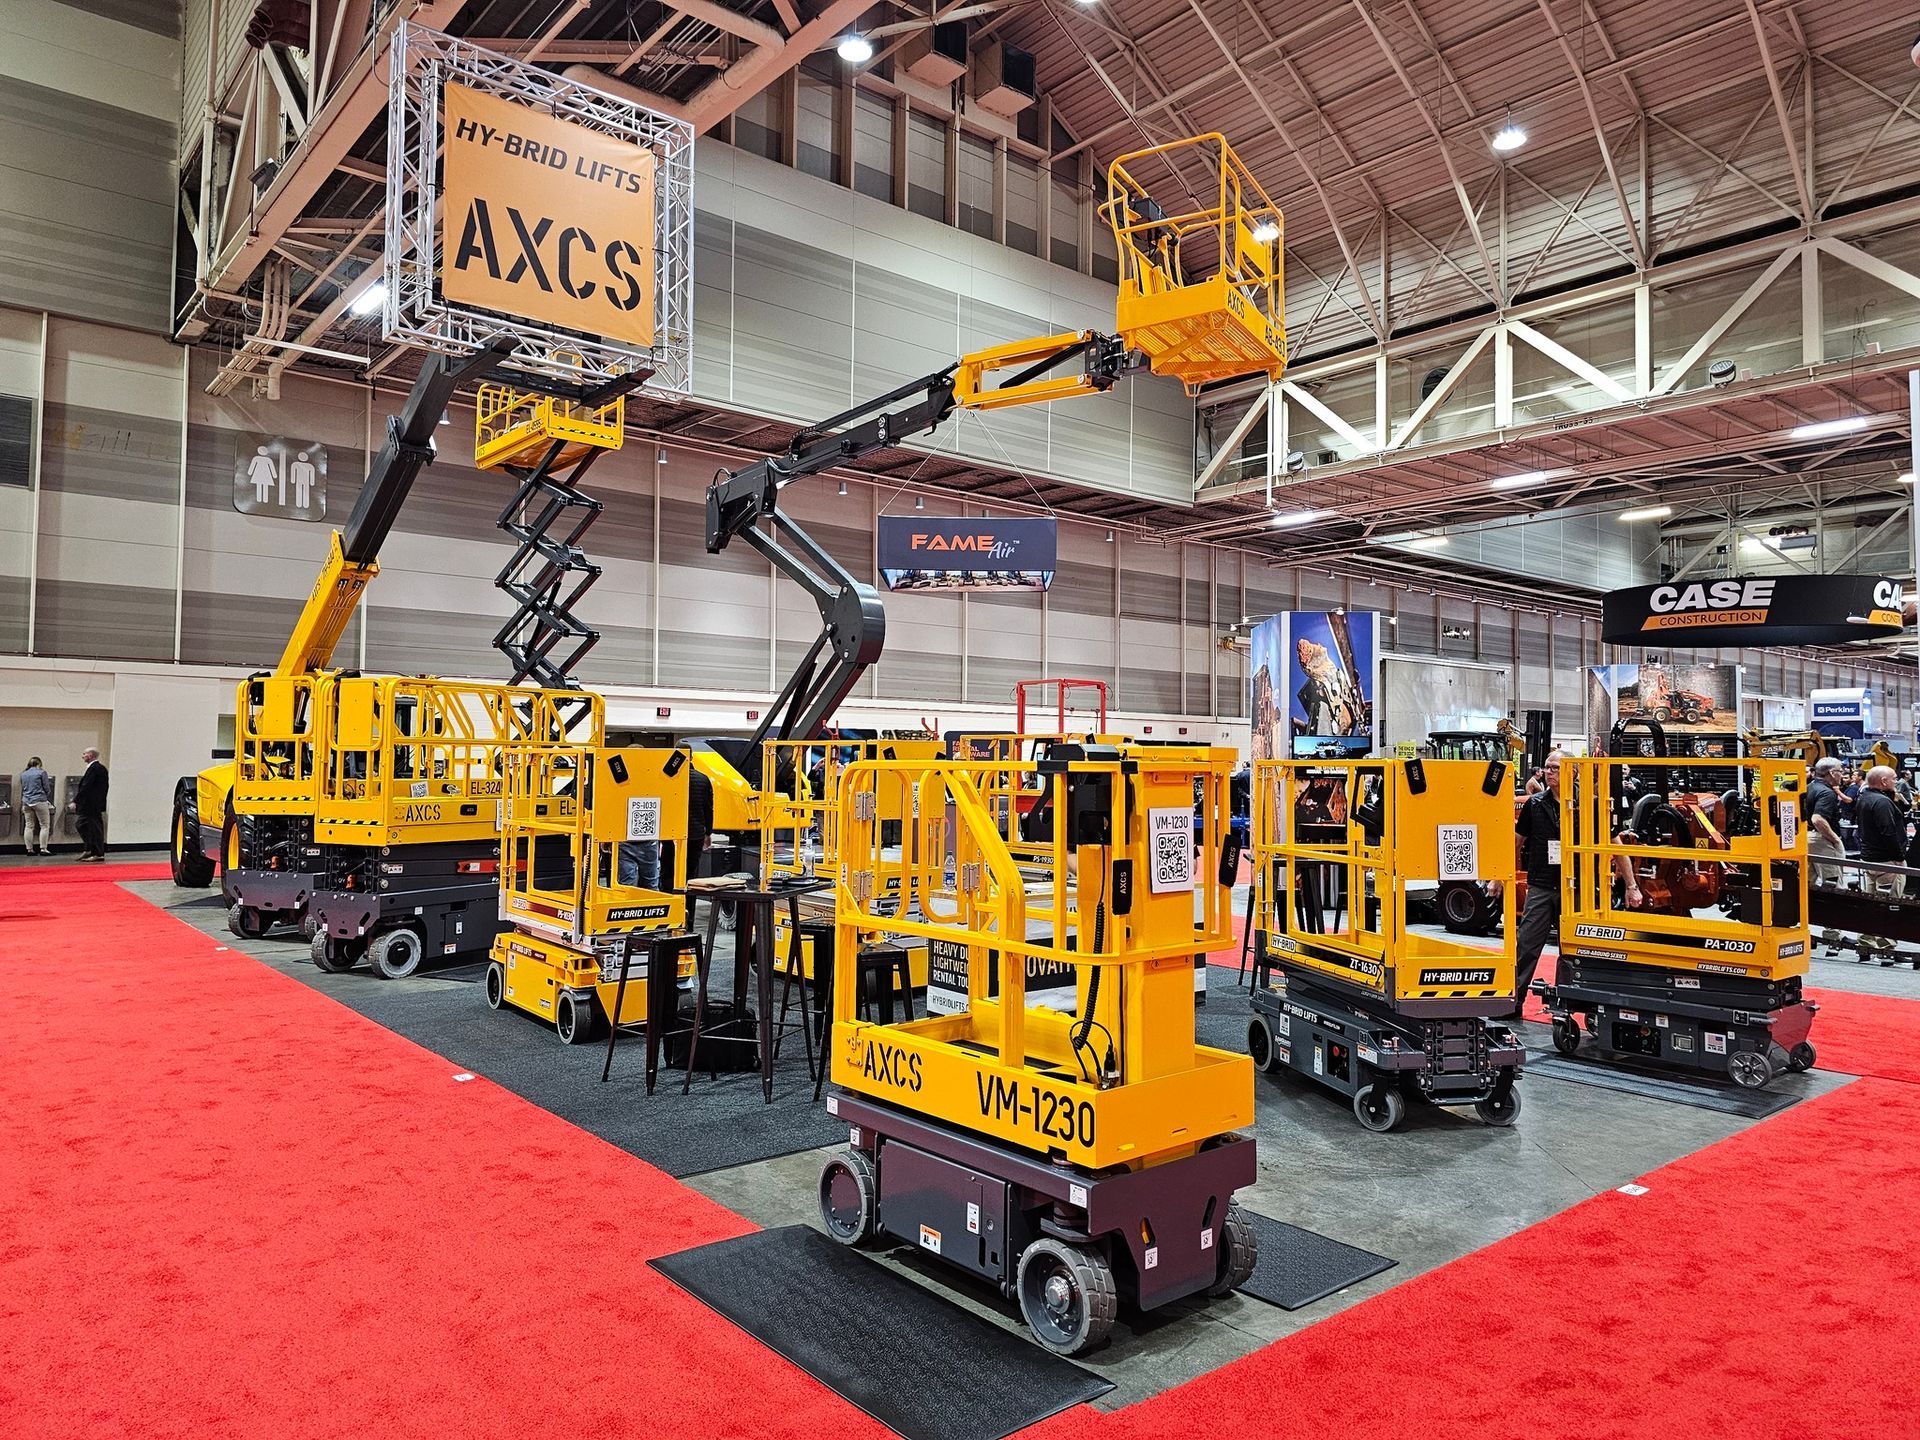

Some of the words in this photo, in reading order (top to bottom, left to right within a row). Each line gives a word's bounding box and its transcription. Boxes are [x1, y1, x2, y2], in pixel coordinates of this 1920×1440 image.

[455, 118, 568, 170] HY-BRID
[575, 156, 641, 194] LIFTS
[454, 197, 641, 311] AXCS
[1227, 288, 1245, 319] AXCS
[911, 534, 995, 551] FAME
[988, 541, 1015, 559] Air
[1649, 580, 1776, 613] CASE
[1660, 611, 1762, 627] CONSTRUCTION
[631, 801, 657, 809] PS-1030
[405, 804, 441, 823] AXCS
[1155, 815, 1189, 829] VM-1230
[1443, 830, 1473, 840] ZT-1630
[1227, 847, 1236, 868] AXCS
[1119, 871, 1127, 894] AXCS
[610, 909, 642, 919] HY-BRID
[644, 907, 665, 917] LIFTS
[1578, 926, 1622, 939] HY-BRID
[933, 941, 959, 957] HEAVY
[1272, 936, 1295, 951] HY-BRID
[1704, 939, 1753, 953] PA-1030
[1349, 958, 1378, 975] ZT-1630
[1697, 963, 1746, 974] HYBRIDLIFTS.COM
[933, 970, 956, 985] RENTAL
[1424, 972, 1462, 982] HY-BRID
[1464, 972, 1489, 982] LIFTS
[1283, 1003, 1303, 1018] HY-BRID
[1303, 1011, 1318, 1023] LIFTS
[864, 1040, 923, 1093] AXCS
[977, 1070, 1096, 1148] VM-1230
